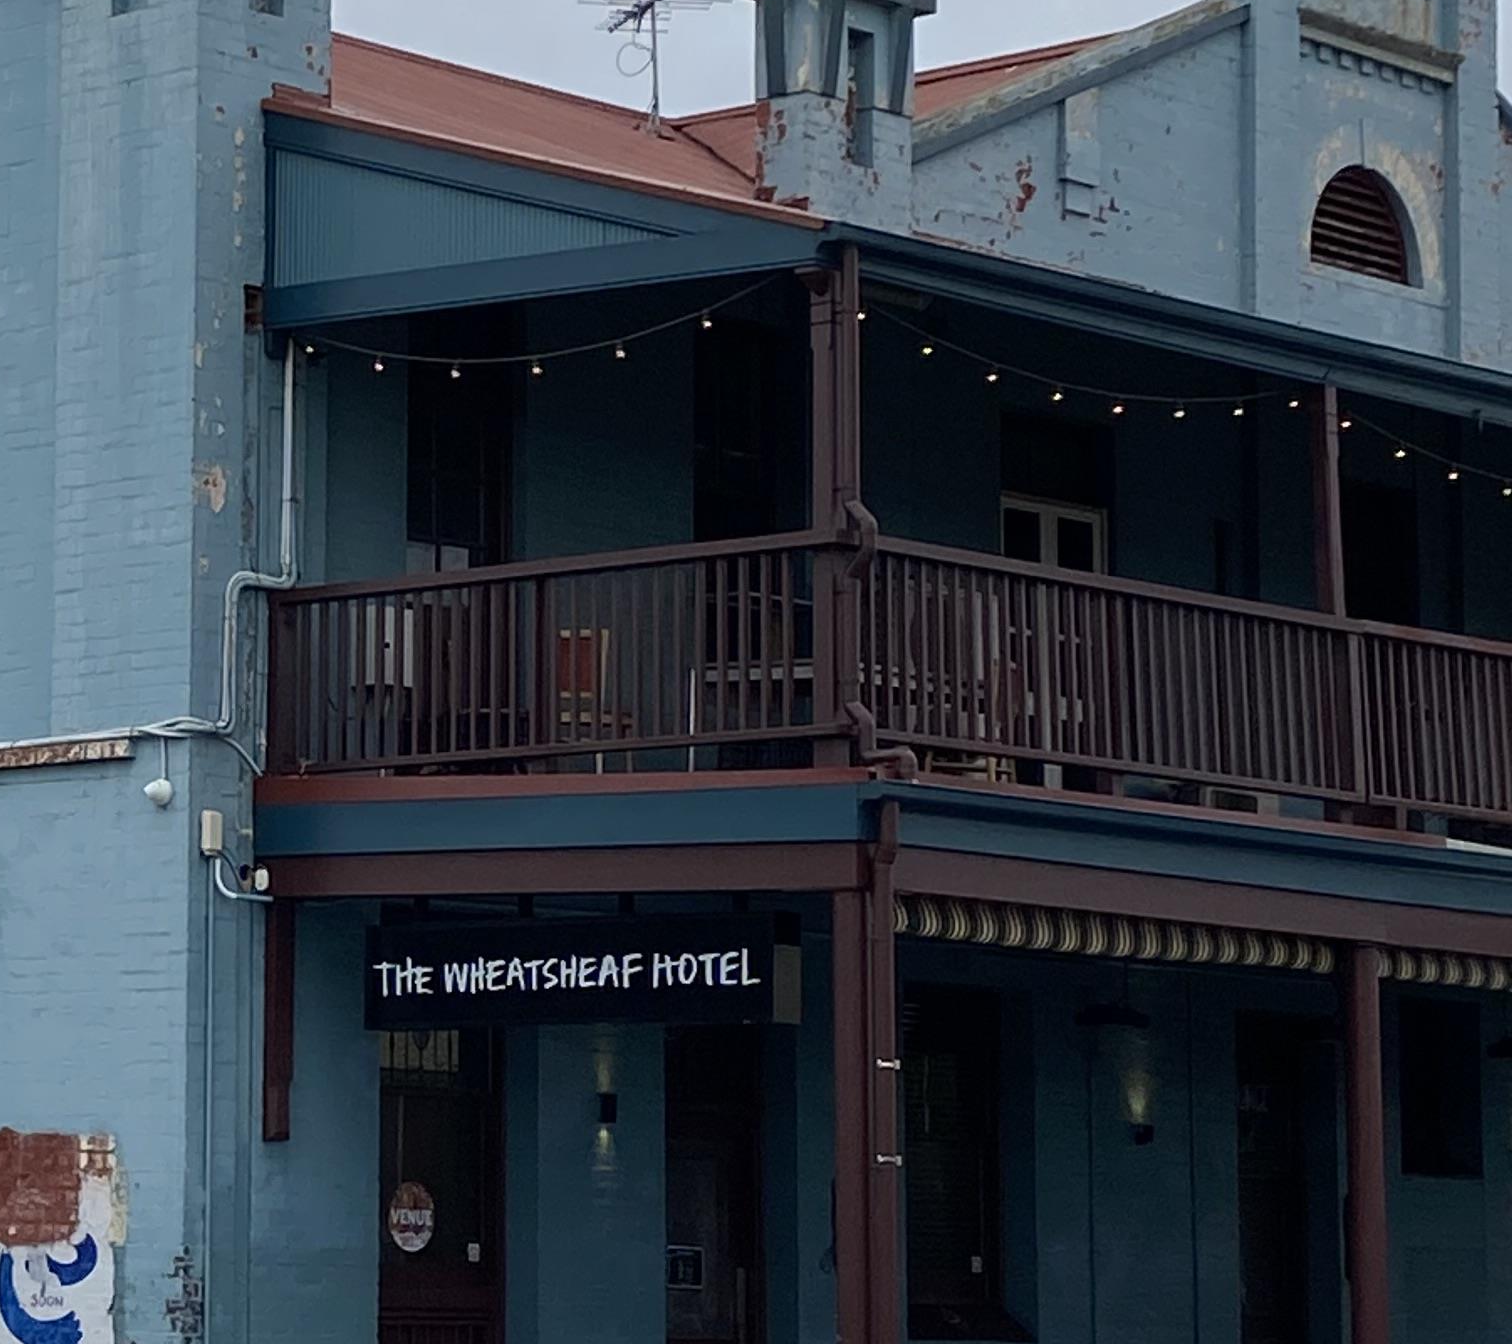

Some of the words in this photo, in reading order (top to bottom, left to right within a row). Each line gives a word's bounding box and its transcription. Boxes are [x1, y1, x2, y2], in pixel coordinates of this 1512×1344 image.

[373, 957, 433, 996] THE
[444, 953, 643, 993] WHEATSHEAF
[652, 948, 760, 988] HOTEL
[390, 1207, 433, 1226] VENUE
